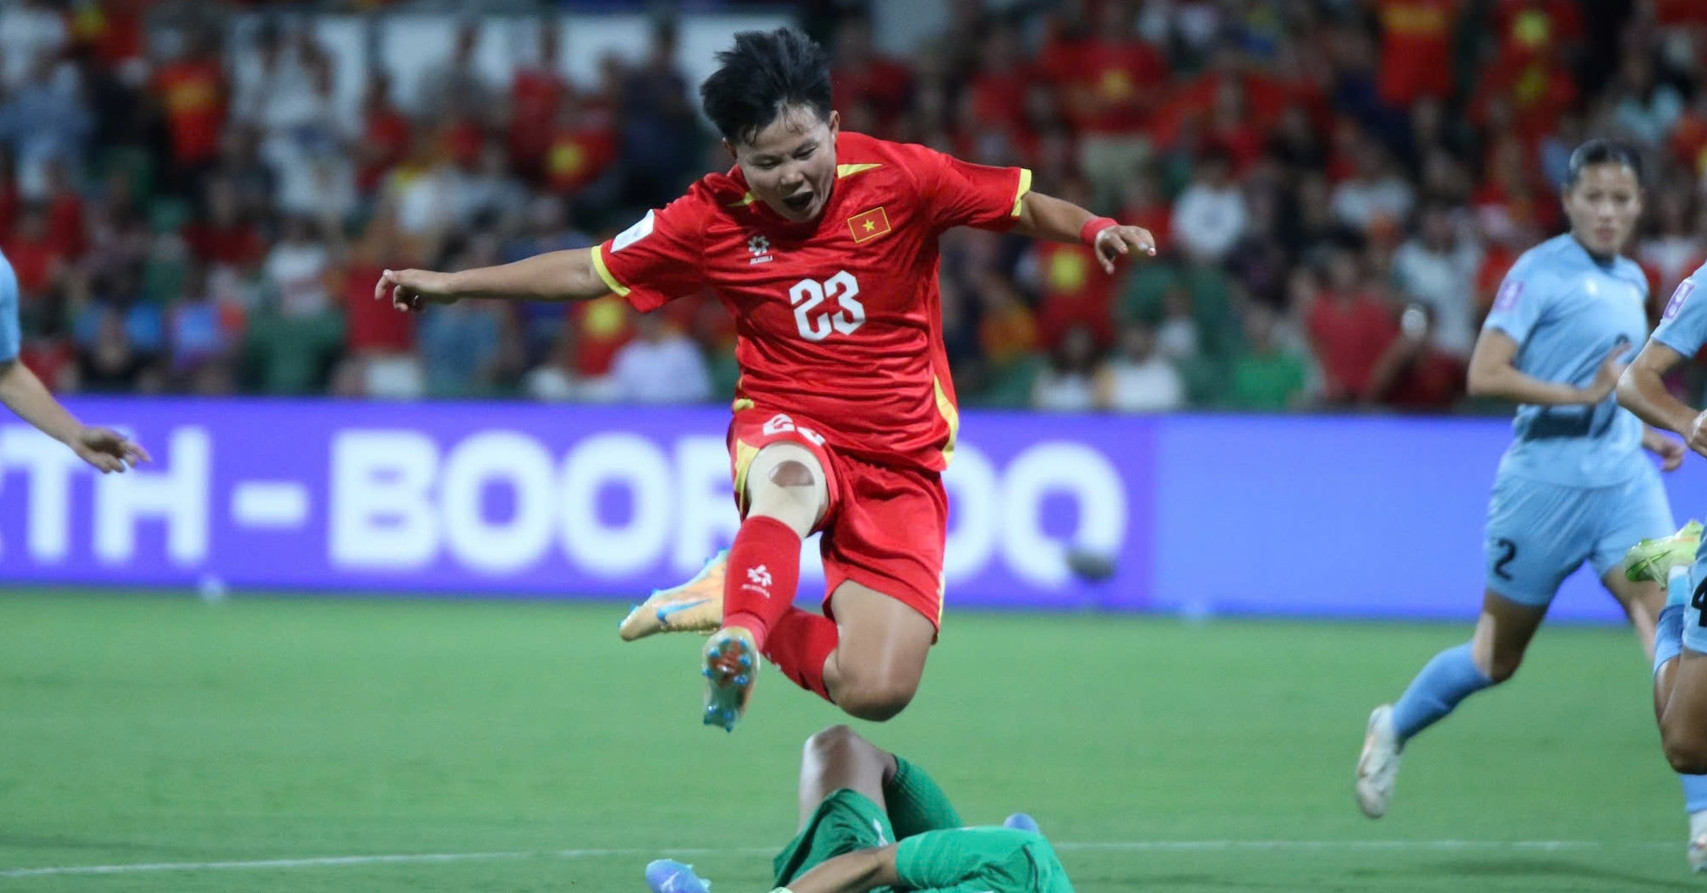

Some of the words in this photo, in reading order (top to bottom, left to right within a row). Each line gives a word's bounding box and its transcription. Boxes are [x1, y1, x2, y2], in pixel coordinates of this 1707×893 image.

[789, 270, 866, 341] 23
[0, 424, 211, 565] TH
[328, 428, 1128, 590] BOORO
[1494, 539, 1517, 581] 2
